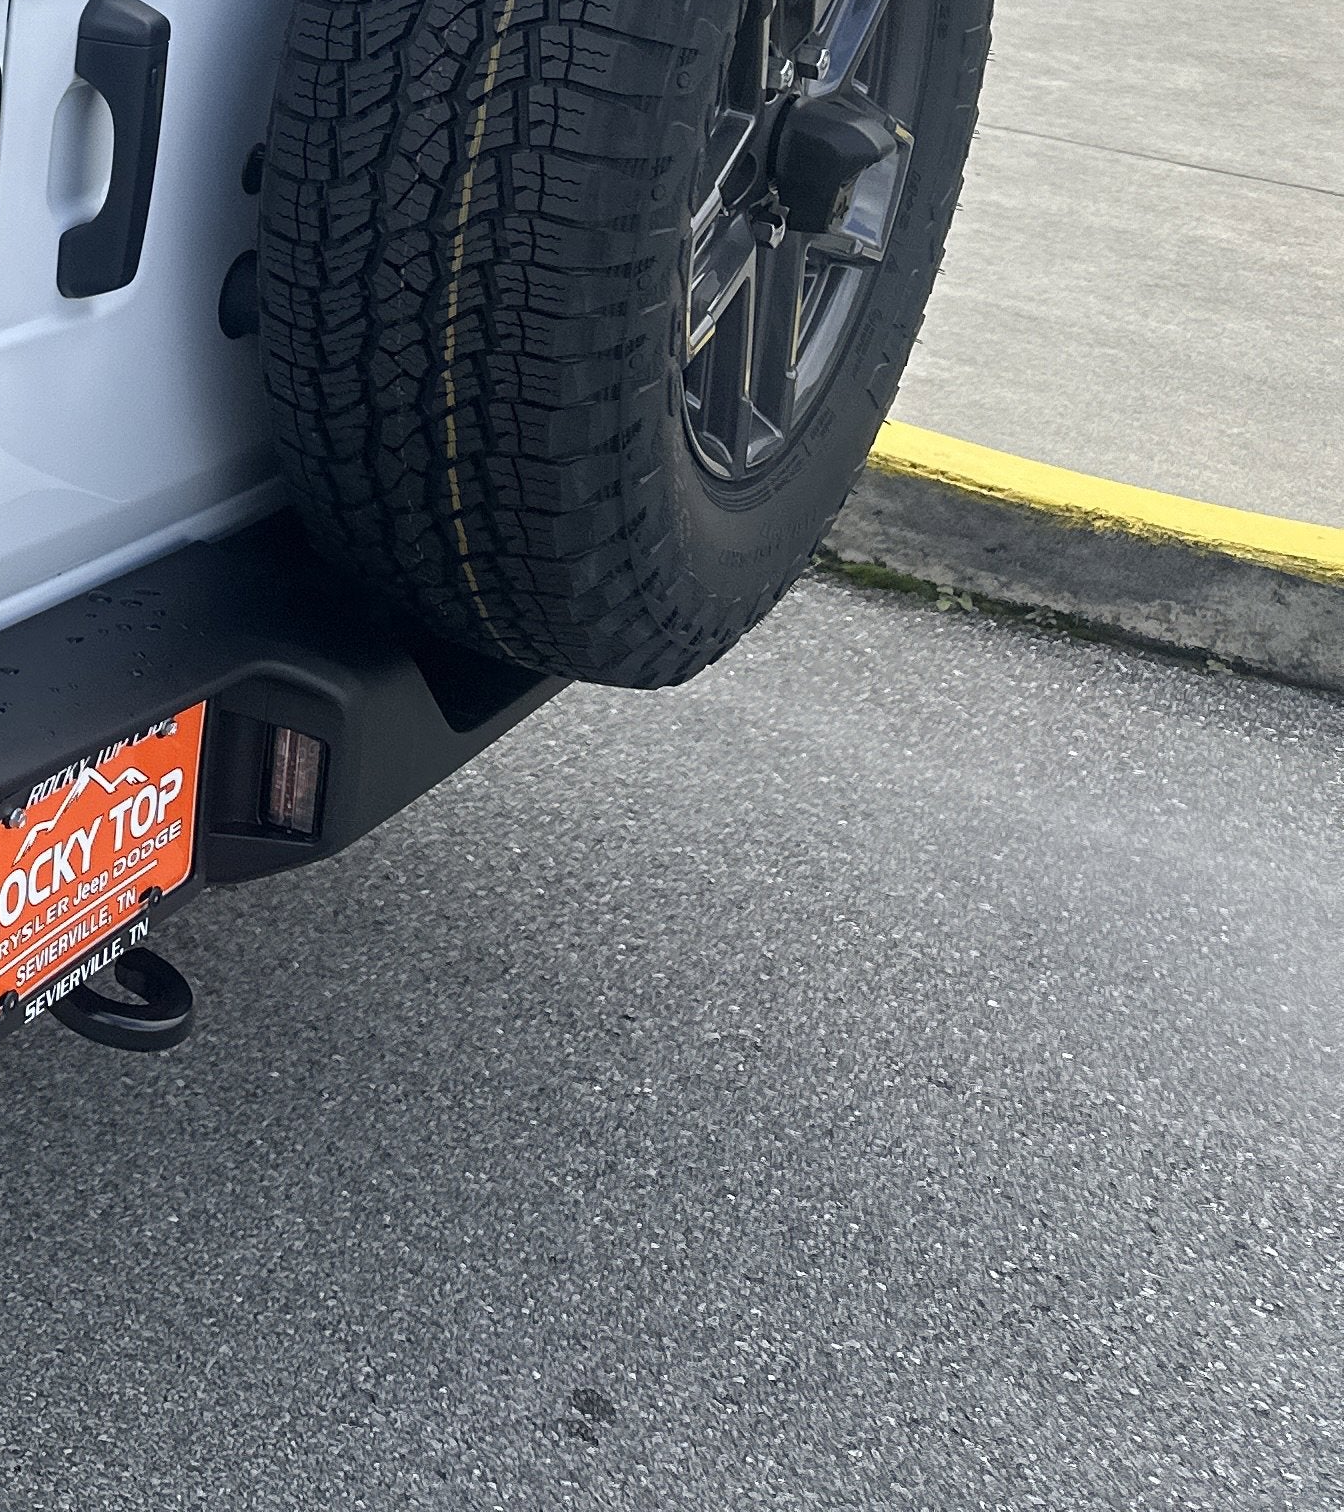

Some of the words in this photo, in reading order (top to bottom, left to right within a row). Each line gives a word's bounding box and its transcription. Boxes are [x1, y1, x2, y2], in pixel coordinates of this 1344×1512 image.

[108, 767, 183, 853] TOP
[72, 870, 109, 906] Jeep
[112, 819, 182, 879] DODGE
[15, 904, 113, 988] SEVIERVILLE,
[116, 885, 138, 915] TN
[24, 937, 125, 1025] SEVIERVILLE,
[128, 917, 150, 948] TN
